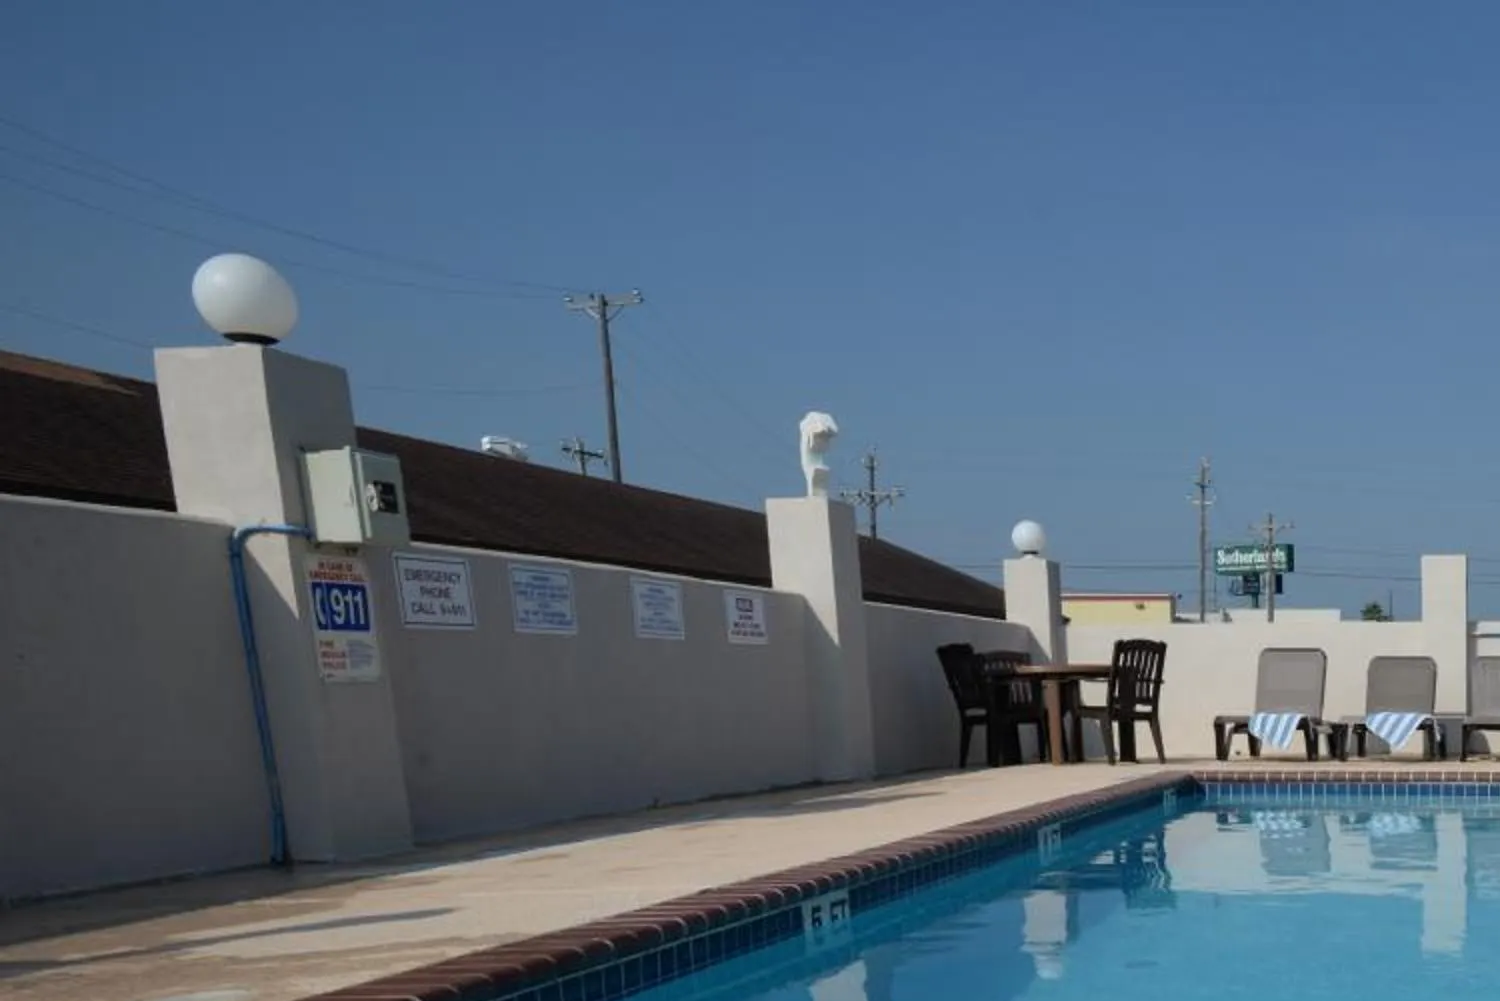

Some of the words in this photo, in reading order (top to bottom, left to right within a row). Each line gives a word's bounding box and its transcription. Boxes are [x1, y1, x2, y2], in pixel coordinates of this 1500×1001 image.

[404, 568, 461, 584] EMERGENCY
[420, 586, 450, 599] PHONE
[331, 588, 365, 625] 911
[411, 602, 437, 615] CALL
